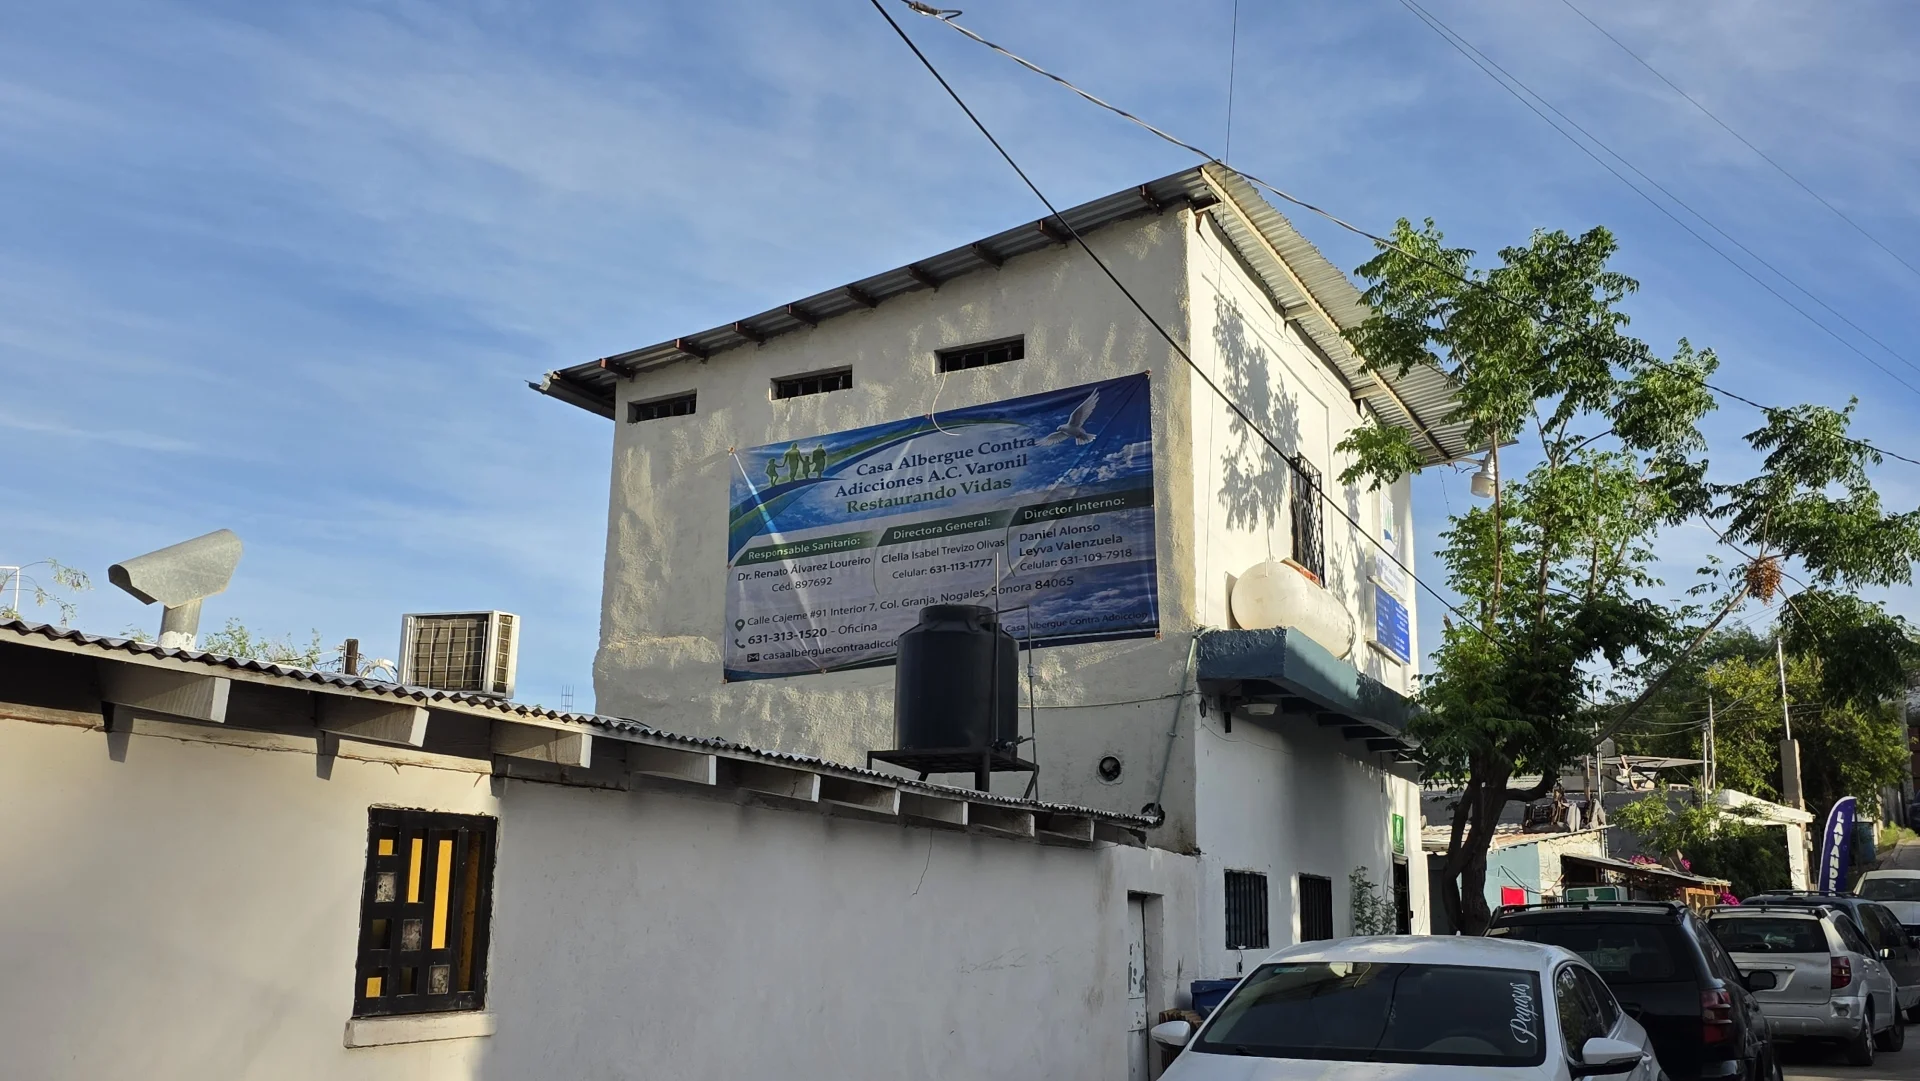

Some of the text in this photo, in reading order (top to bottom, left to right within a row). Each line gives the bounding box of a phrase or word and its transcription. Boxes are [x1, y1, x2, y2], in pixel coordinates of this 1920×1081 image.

[856, 437, 1036, 477] Casa Albergue Contra
[834, 453, 1028, 498] Adicciones A.C. Varonil
[846, 476, 1012, 514] Restaurando Vidas
[1024, 496, 1125, 520] Director Interno:
[893, 516, 991, 541] Directora General:
[1019, 523, 1101, 543] Daniel Alonso
[748, 536, 861, 561] Responsable Sanitario:
[911, 547, 939, 560] Isabel
[941, 543, 975, 556] Trevizo
[976, 539, 1005, 550] Olivas
[1019, 533, 1123, 560] Leyva Valenzuela
[737, 555, 871, 582] Dr. Renato Álvarez Loureiro
[892, 558, 993, 580] Celular: 631-113-1777
[1019, 559, 1058, 572] Celular:
[771, 576, 833, 593] Céd. 897692
[747, 575, 1074, 626] Calle Cajeme #91 Interior 7, Col. Granja, Nogales, Sonora 84065
[747, 627, 828, 645] 631-313-1520
[837, 622, 878, 635] Oficina
[1005, 624, 1026, 632] Casa
[1069, 616, 1100, 626] Contra
[1509, 982, 1539, 1044] Pegasus
